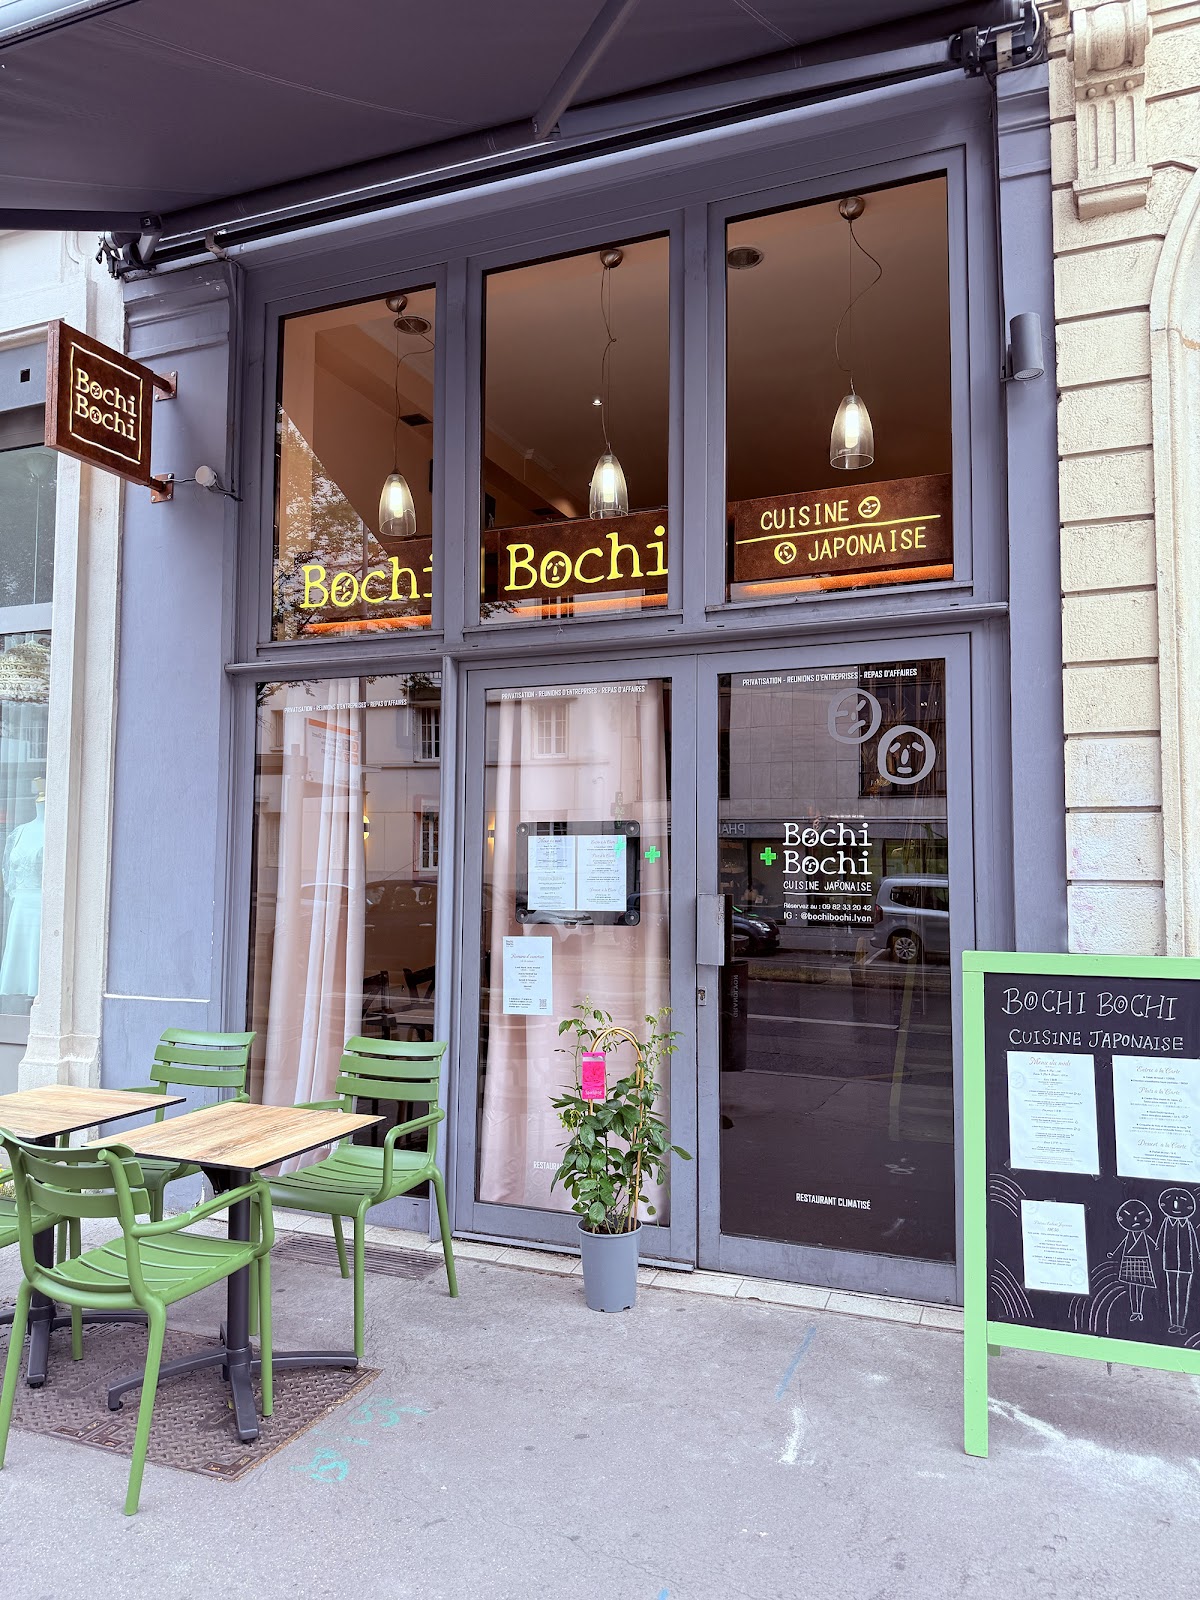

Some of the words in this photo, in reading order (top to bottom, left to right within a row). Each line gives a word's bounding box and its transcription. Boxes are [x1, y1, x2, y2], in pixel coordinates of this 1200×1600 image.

[75, 367, 137, 418] Bochi
[74, 392, 136, 441] Bochi
[760, 499, 849, 531] CUISINE
[807, 526, 927, 561] JAPONAISE
[504, 525, 669, 592] Bochi
[742, 676, 782, 686] PRIVATISATION
[863, 669, 883, 679] REPAS
[883, 668, 918, 678] D'AFFAIRES
[501, 691, 534, 700] PRIVATISATION
[601, 685, 617, 694] REPAS
[782, 822, 873, 847] Bochi
[782, 850, 873, 875] Bochi
[783, 880, 820, 891] CUISINE
[824, 881, 872, 892] JAPONAISE
[783, 902, 809, 910] Réservez
[822, 903, 831, 911] 09
[832, 903, 841, 911] 82
[842, 903, 851, 911] 33
[852, 903, 861, 911] 20
[862, 904, 872, 912] 42
[783, 912, 792, 920] IG
[801, 912, 872, 923] @bochibochi.lyon
[1001, 987, 1086, 1015] BOCHI
[1096, 991, 1178, 1021] BOCHI
[1009, 1028, 1081, 1046] CUISINE
[1088, 1029, 1184, 1051] JAPONAISE
[795, 1192, 837, 1206] RESTAURANT
[837, 1197, 871, 1210] CLIMATISÉ
